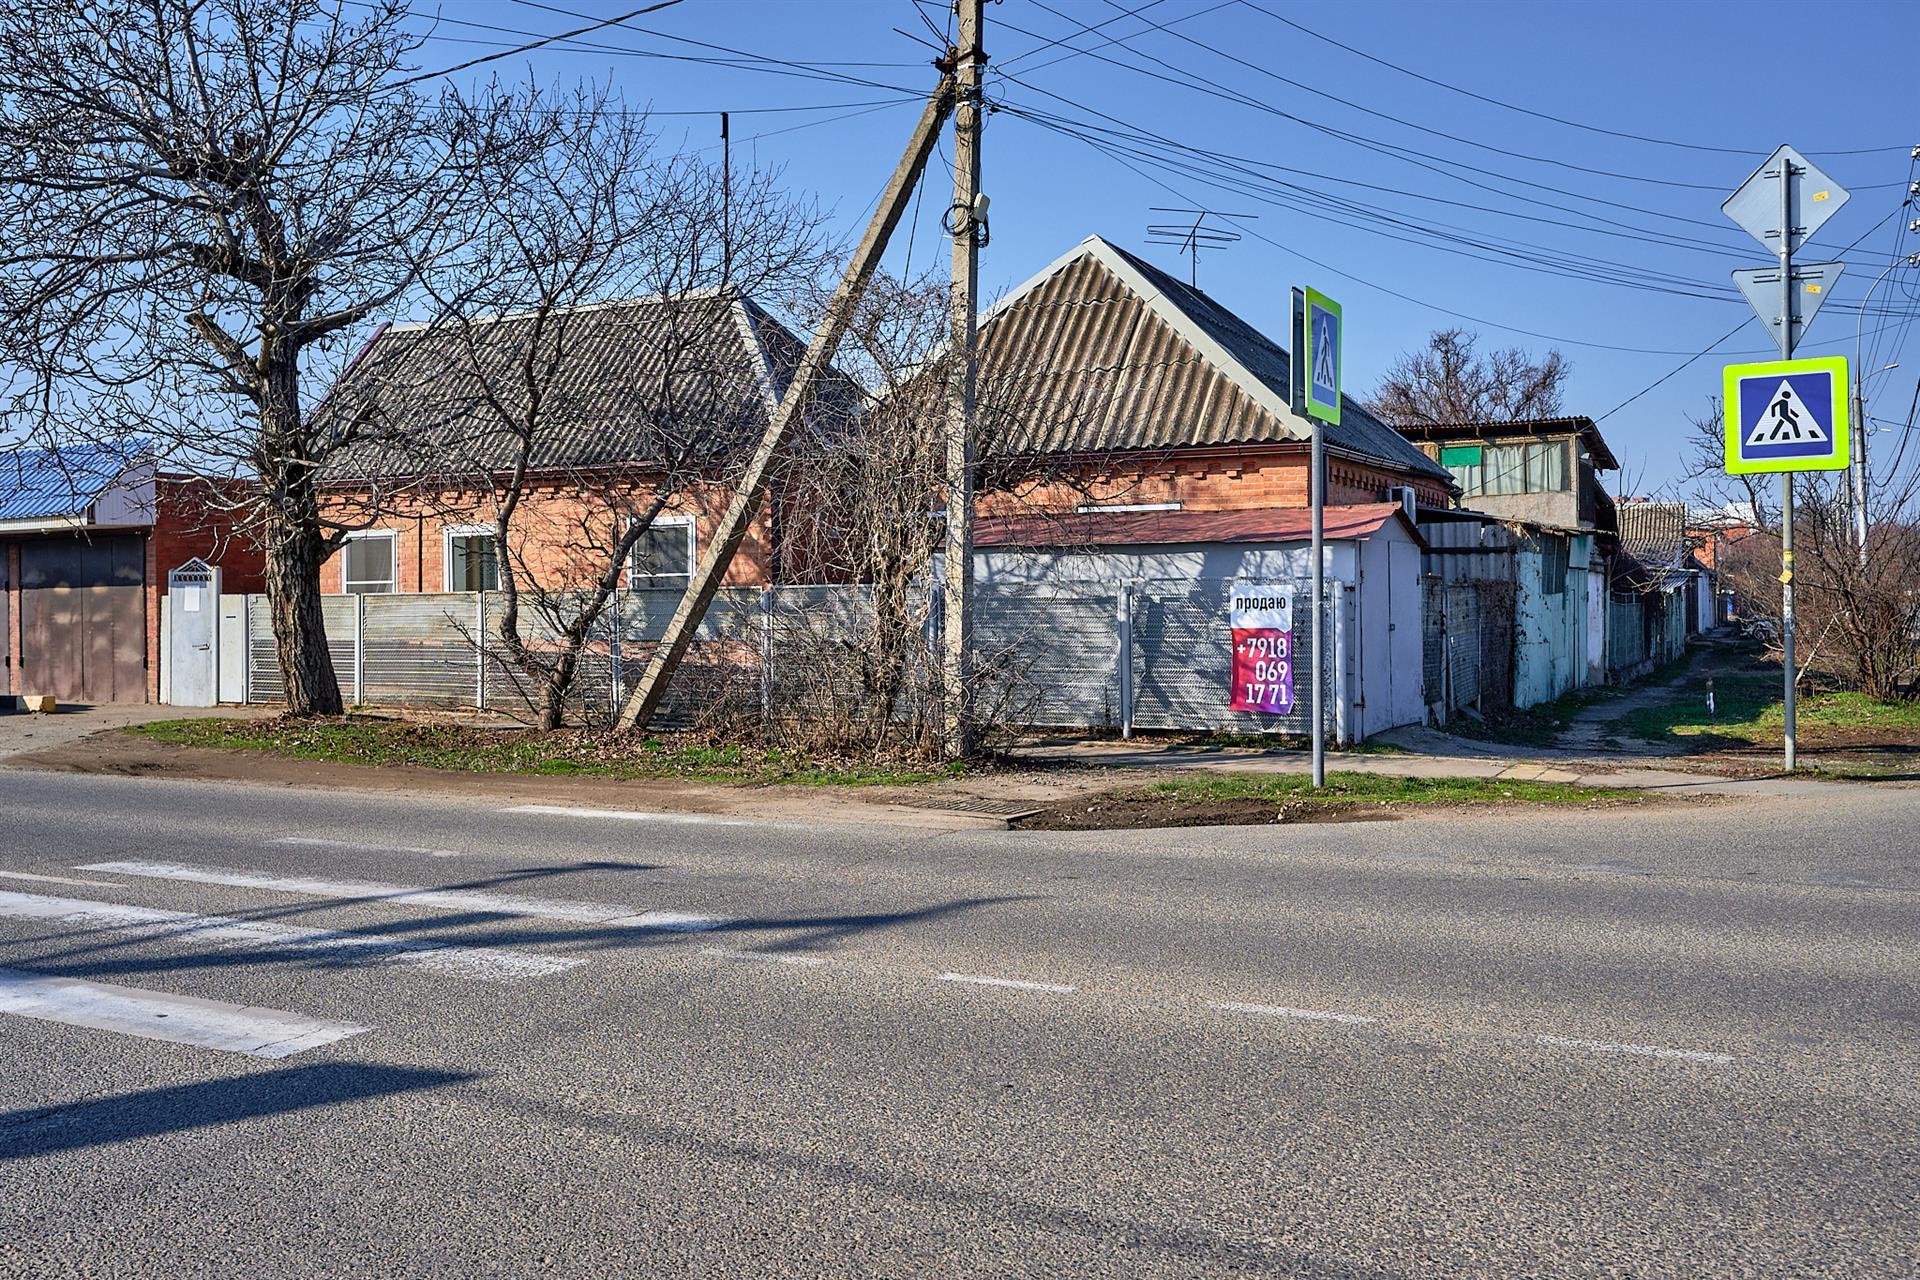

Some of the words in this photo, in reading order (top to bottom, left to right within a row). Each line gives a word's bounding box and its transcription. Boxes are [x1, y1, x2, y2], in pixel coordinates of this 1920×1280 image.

[1236, 597, 1286, 613] продаю
[1237, 637, 1287, 658] +7918
[1255, 661, 1288, 681] 069
